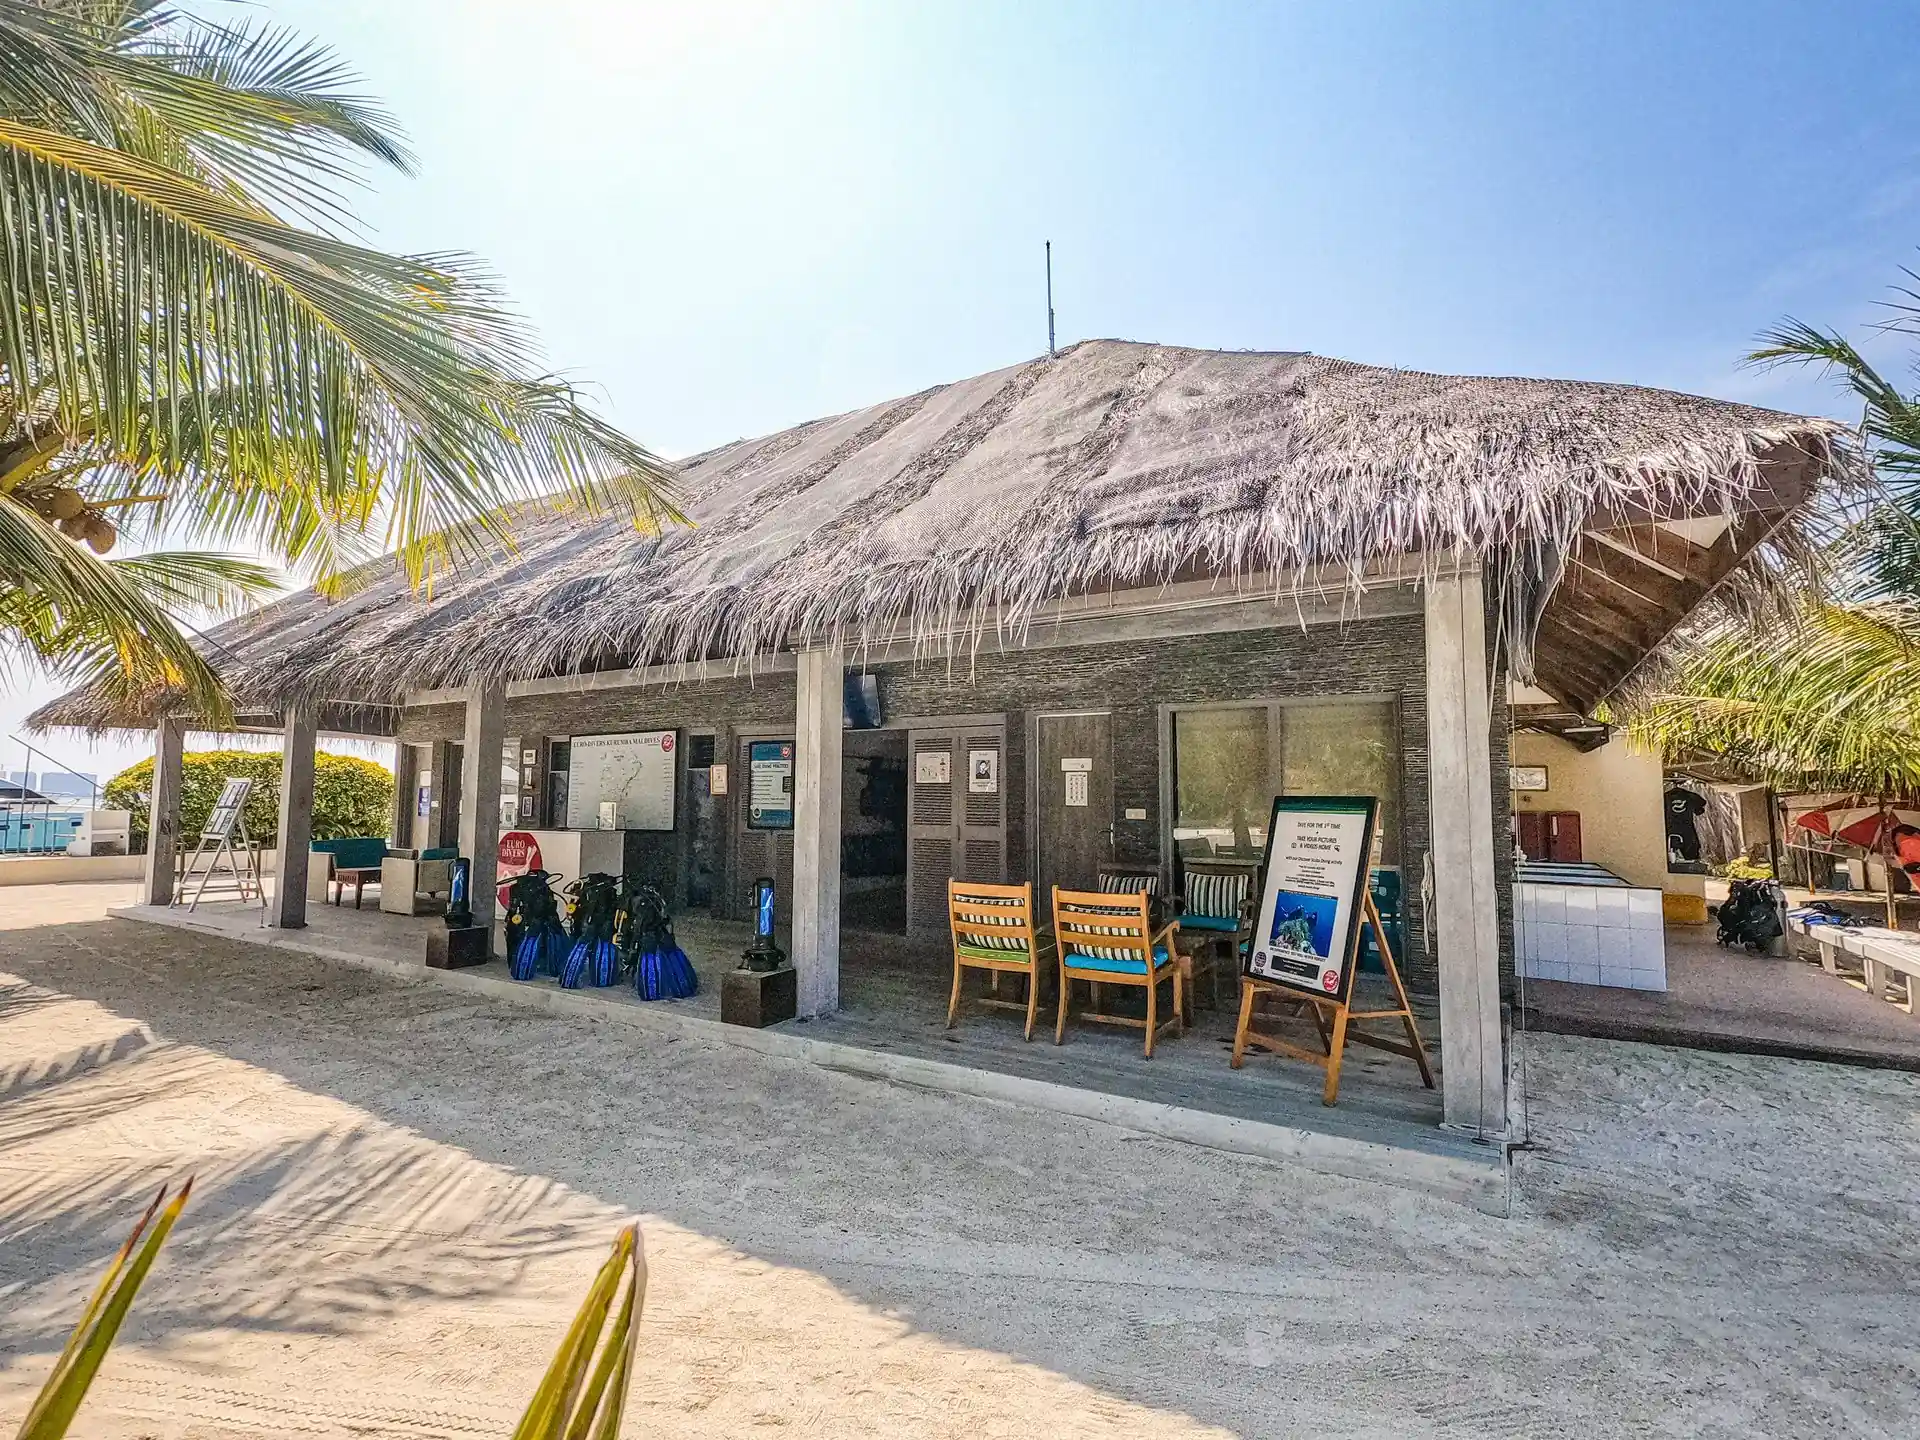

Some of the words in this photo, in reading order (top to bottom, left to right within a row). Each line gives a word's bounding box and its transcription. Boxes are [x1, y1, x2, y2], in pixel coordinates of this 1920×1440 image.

[632, 736, 660, 745] MALDIVES
[507, 839, 525, 848] EURO
[502, 848, 525, 857] DIVERS
